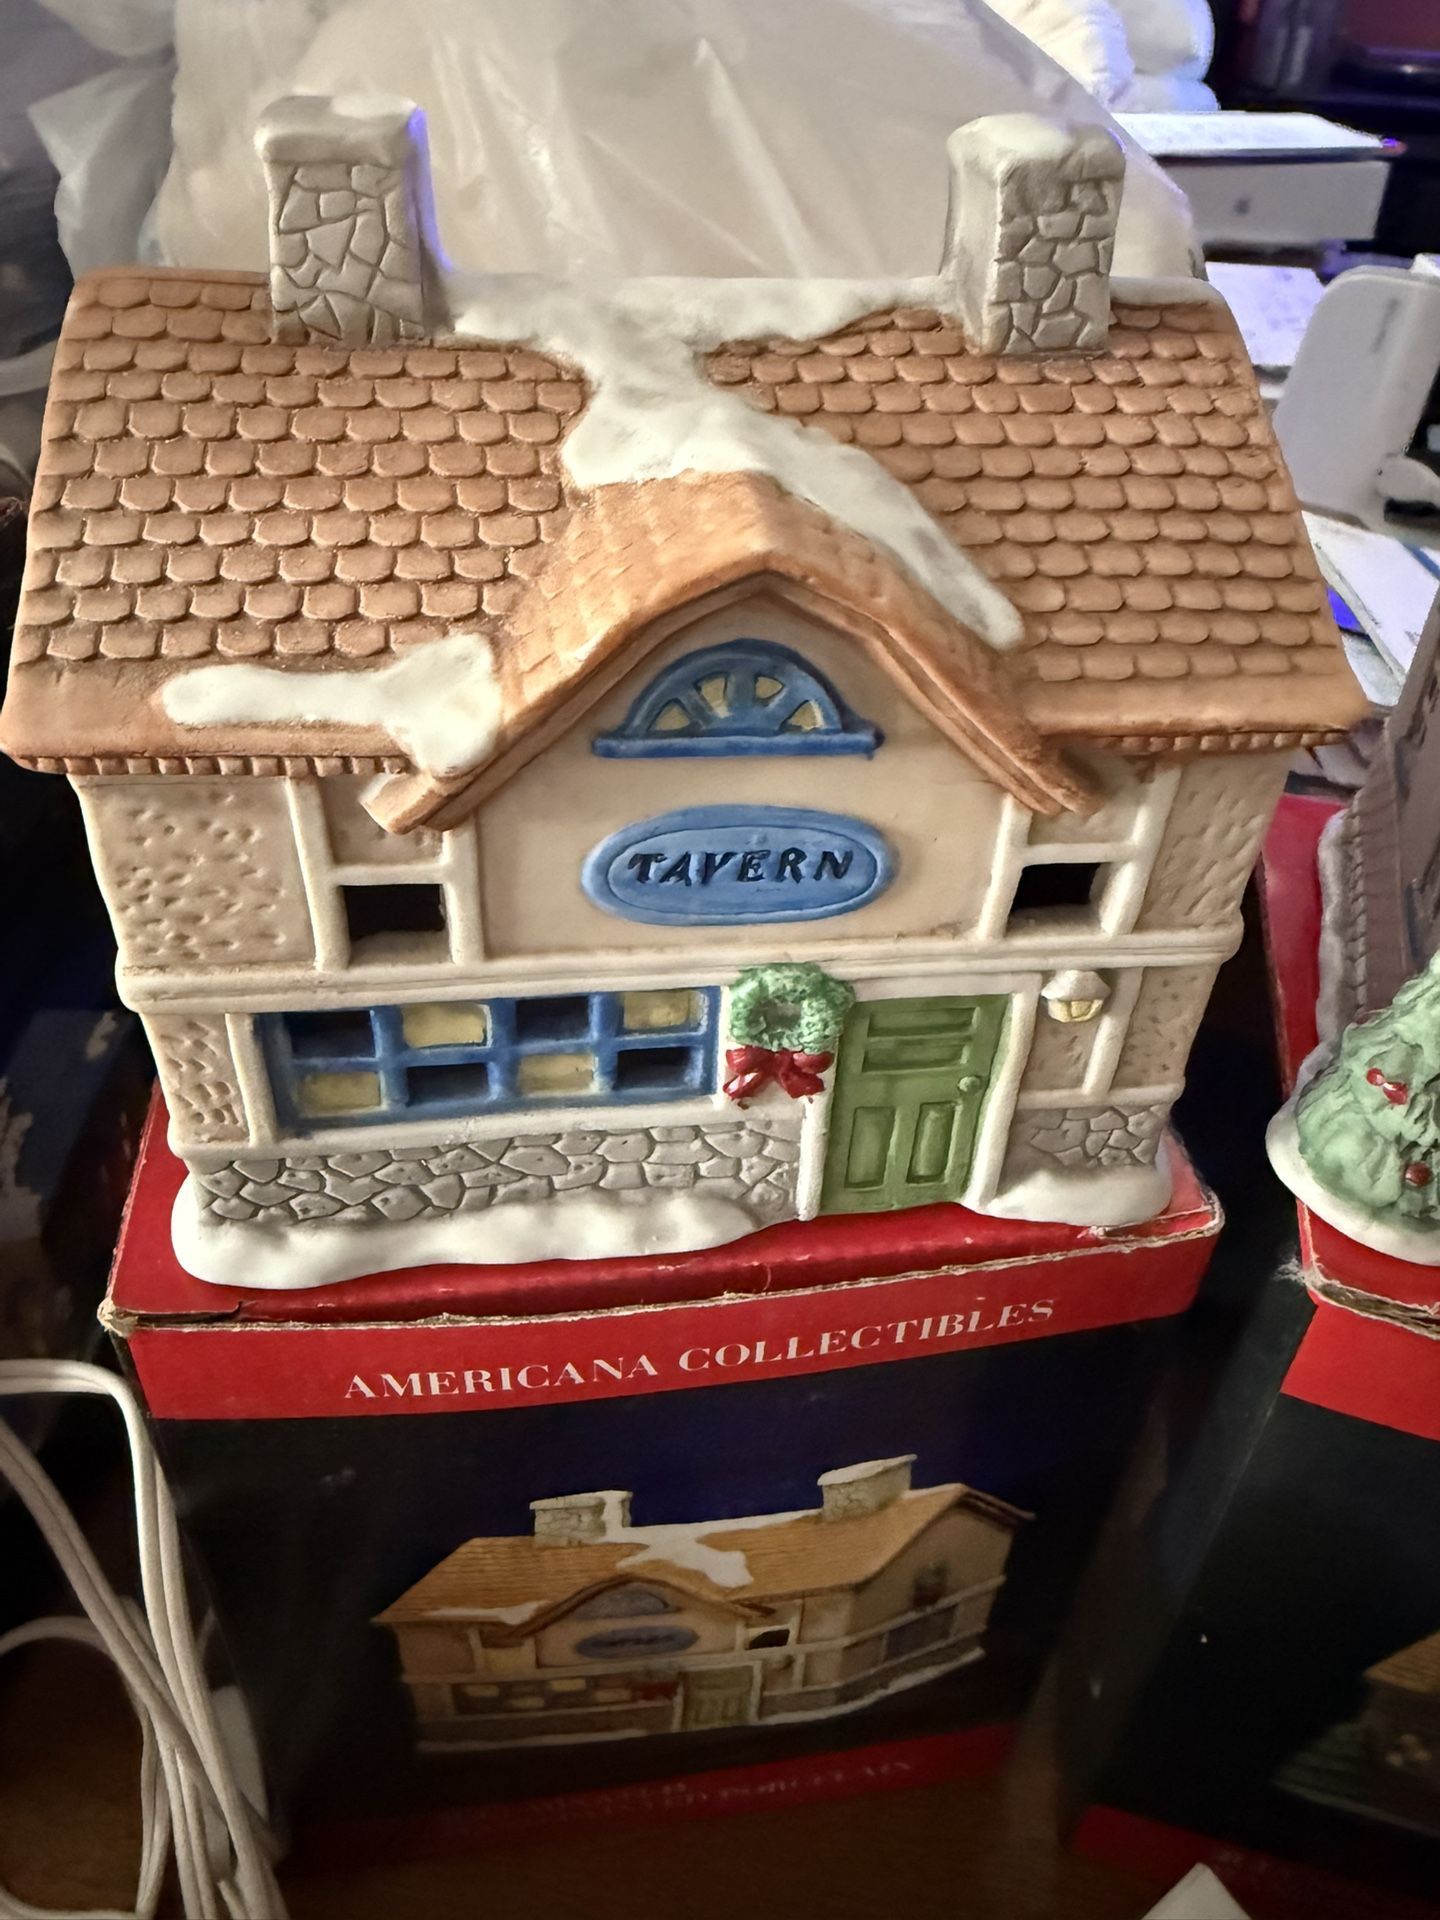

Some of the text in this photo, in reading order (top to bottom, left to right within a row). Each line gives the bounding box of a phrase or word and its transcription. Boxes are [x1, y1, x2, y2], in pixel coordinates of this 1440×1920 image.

[627, 847, 853, 886] TAVERN
[345, 1300, 1054, 1399] AMERICANA COLLECTIBLES
